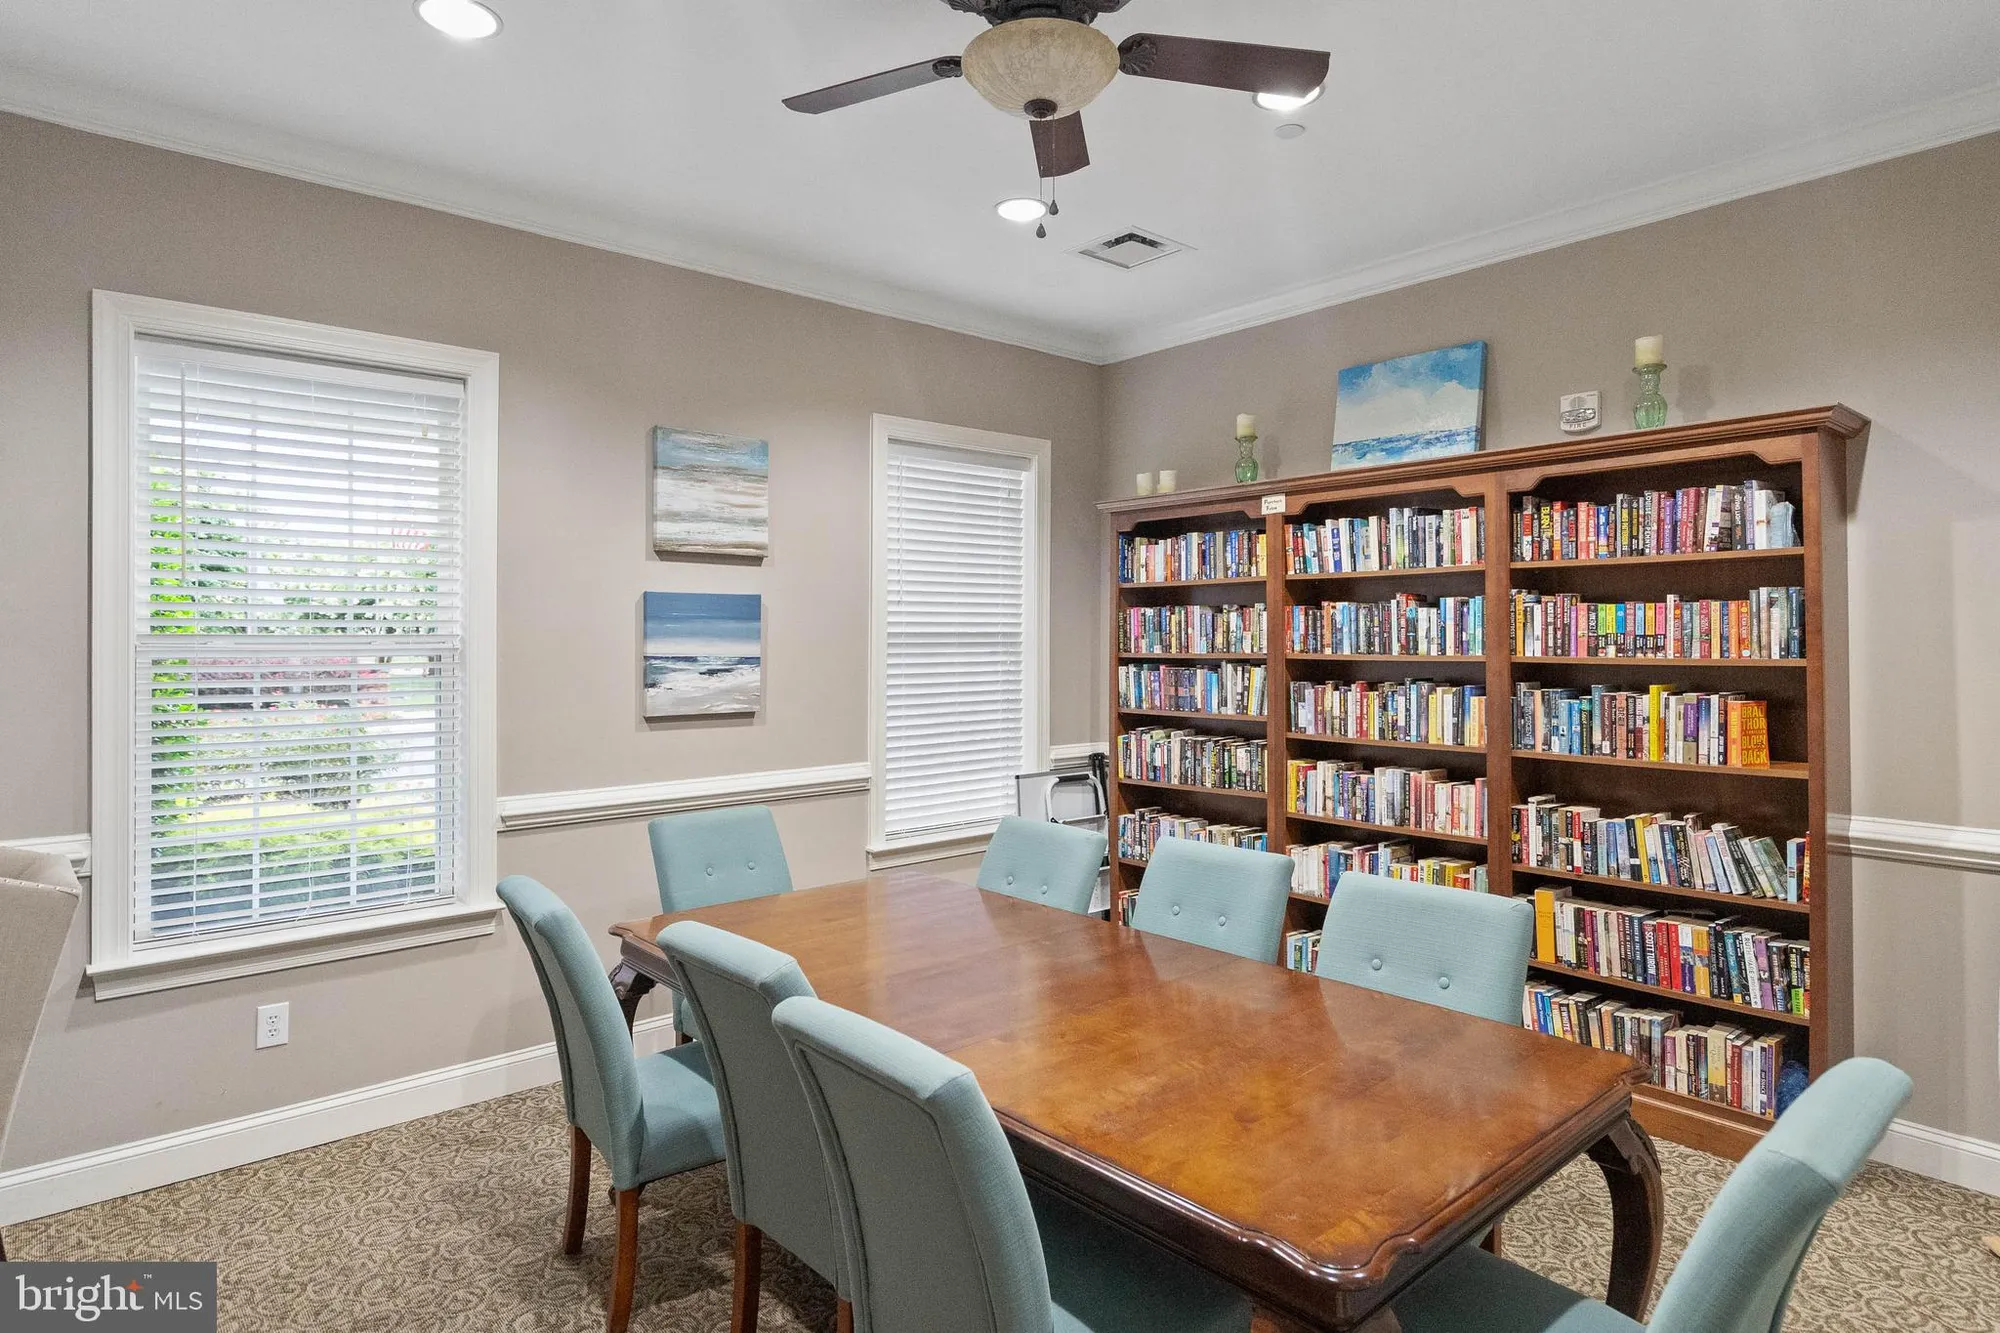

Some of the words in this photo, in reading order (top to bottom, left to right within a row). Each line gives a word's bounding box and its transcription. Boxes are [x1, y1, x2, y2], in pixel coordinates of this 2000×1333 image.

[1541, 506, 1550, 528] BURN
[1742, 706, 1764, 718] BRAD
[1742, 718, 1767, 729] THOR
[1742, 734, 1766, 748] BLOW
[1742, 749, 1768, 765] BACK
[1646, 932, 1655, 951] SCOTT
[1744, 938, 1753, 954] RUTH
[1647, 952, 1656, 975] TUROW
[1747, 958, 1756, 974] WARE
[1561, 1012, 1570, 1032] WHITE
